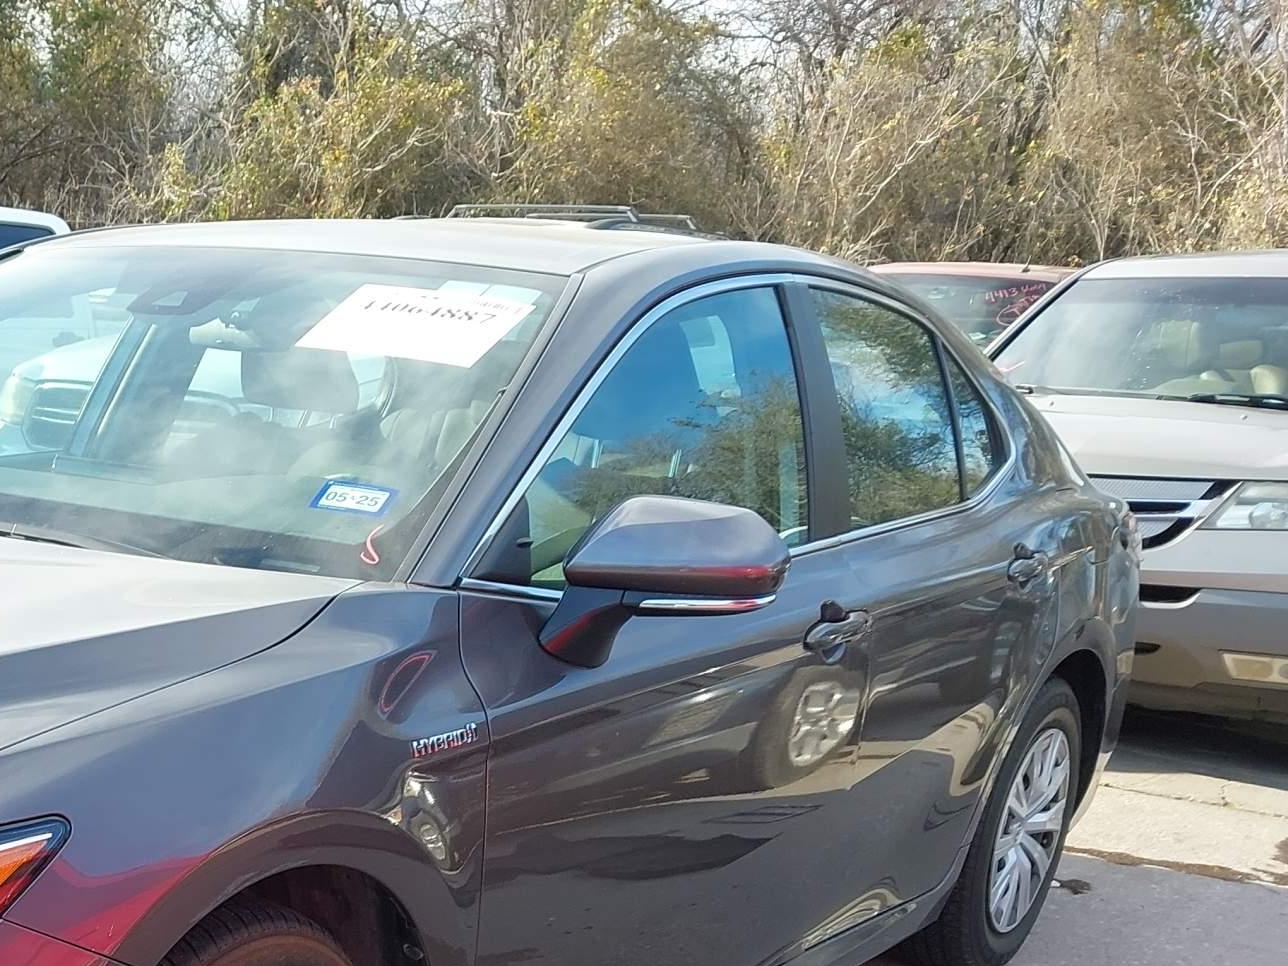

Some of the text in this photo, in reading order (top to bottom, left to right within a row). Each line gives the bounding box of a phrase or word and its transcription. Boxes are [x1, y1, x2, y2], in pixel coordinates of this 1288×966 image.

[325, 491, 381, 508] 05 25
[411, 728, 468, 758] HYBRID
